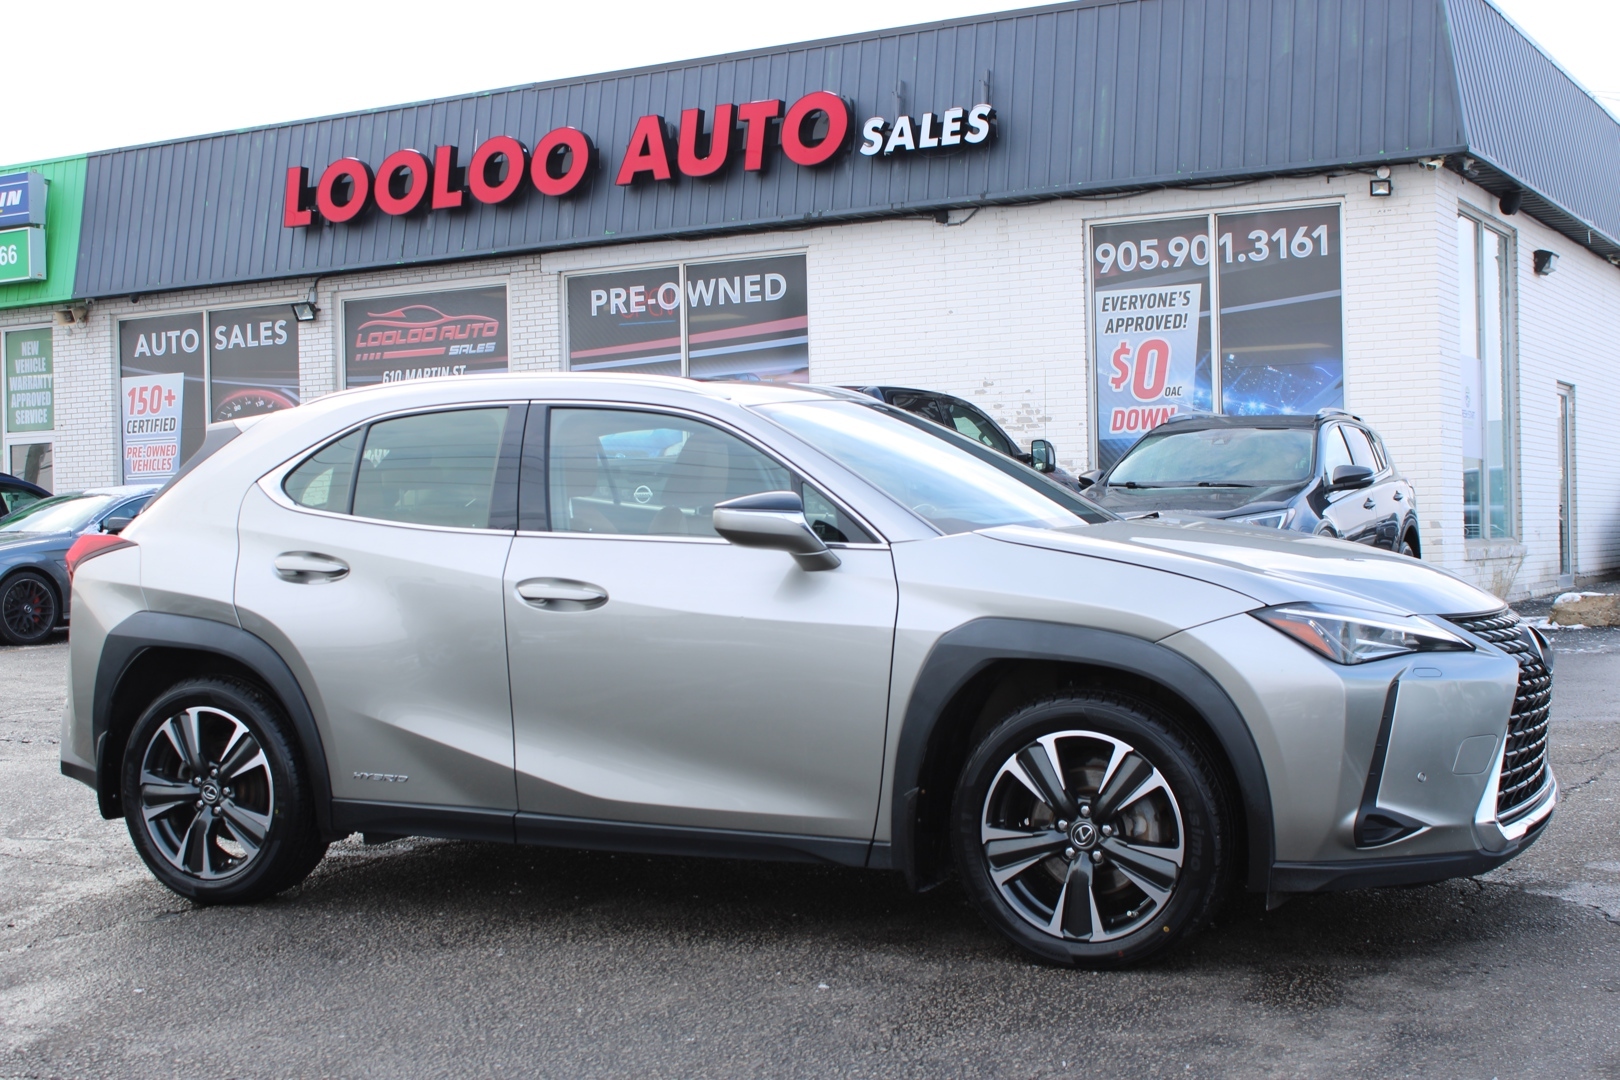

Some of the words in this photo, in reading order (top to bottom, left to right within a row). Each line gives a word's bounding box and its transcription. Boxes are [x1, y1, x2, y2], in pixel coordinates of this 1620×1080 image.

[284, 126, 589, 228] LOOLOO
[615, 90, 848, 186] AUTO
[860, 103, 993, 157] SALES
[1095, 224, 1328, 274] 905.901.3161
[590, 273, 787, 317] PRE-OWNED
[1101, 290, 1191, 312] EVERYONE'S
[1104, 313, 1189, 335] APPROVED!
[134, 328, 200, 358] AUTO
[214, 319, 288, 351] SALES
[355, 327, 438, 349] LOOLOO
[439, 321, 500, 341] AUTO
[21, 341, 40, 356] NEW
[448, 342, 497, 356] SALES
[15, 357, 46, 374] VEHICLE
[383, 370, 402, 383] 610
[404, 366, 449, 380] MARTIN
[453, 365, 467, 376] ST
[1110, 339, 1170, 400] $0
[9, 374, 53, 391] WARRANTY
[1164, 386, 1183, 397] OAC
[11, 391, 51, 408] APPROVED
[127, 384, 176, 416] 150+
[15, 409, 48, 425] SERVICE
[126, 417, 177, 434] CERTIFIED
[1112, 408, 1177, 431] DOWN
[126, 445, 177, 460] PRE-OWNED
[131, 458, 173, 473] VEHICLES
